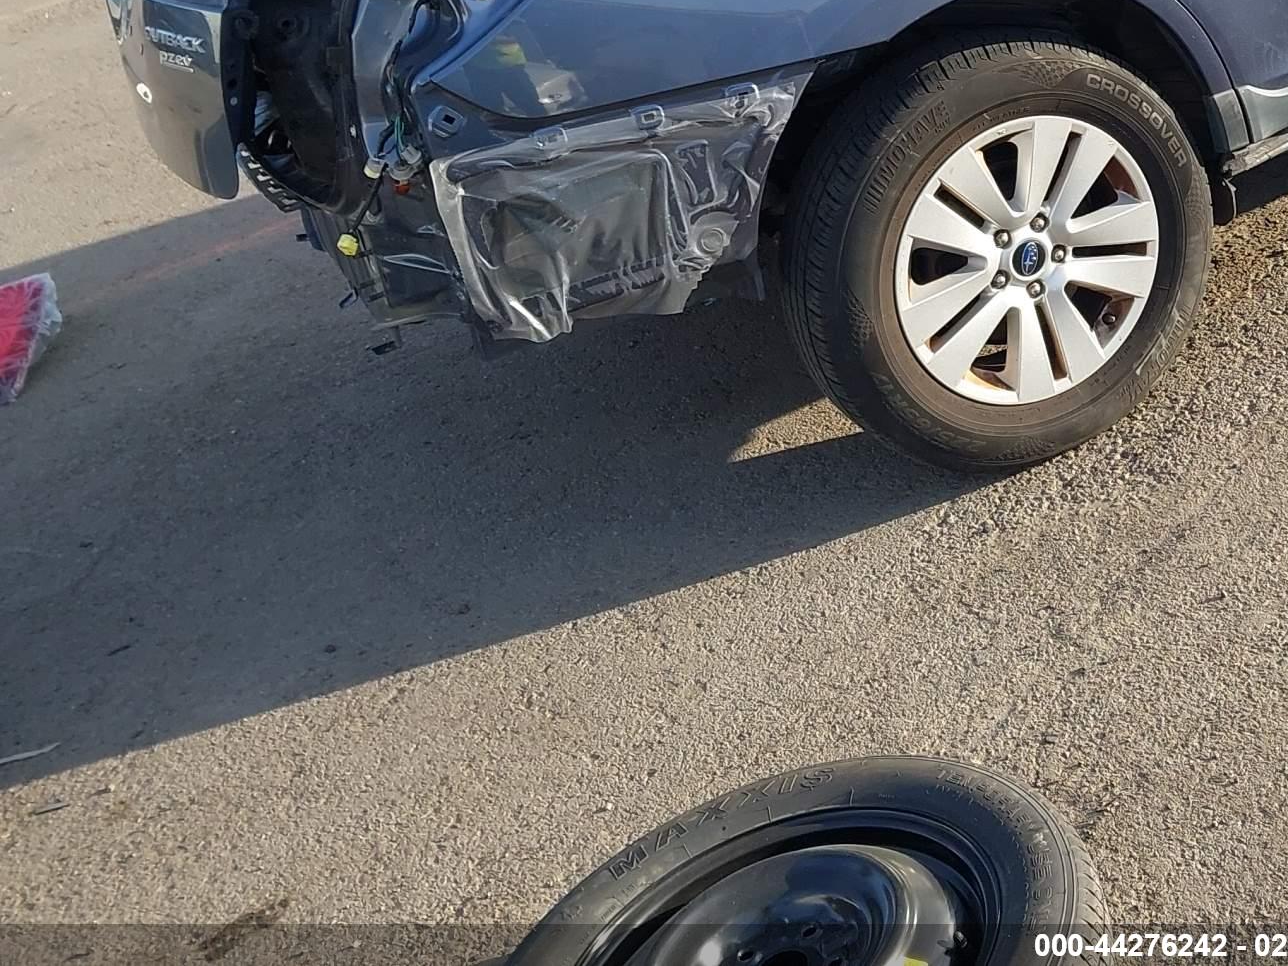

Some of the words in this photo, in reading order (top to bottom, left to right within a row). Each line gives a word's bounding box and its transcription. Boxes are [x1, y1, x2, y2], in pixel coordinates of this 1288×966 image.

[144, 25, 206, 53] OUTBACK
[1086, 73, 1187, 167] CROSSOVER
[608, 768, 834, 880] MAXXIS
